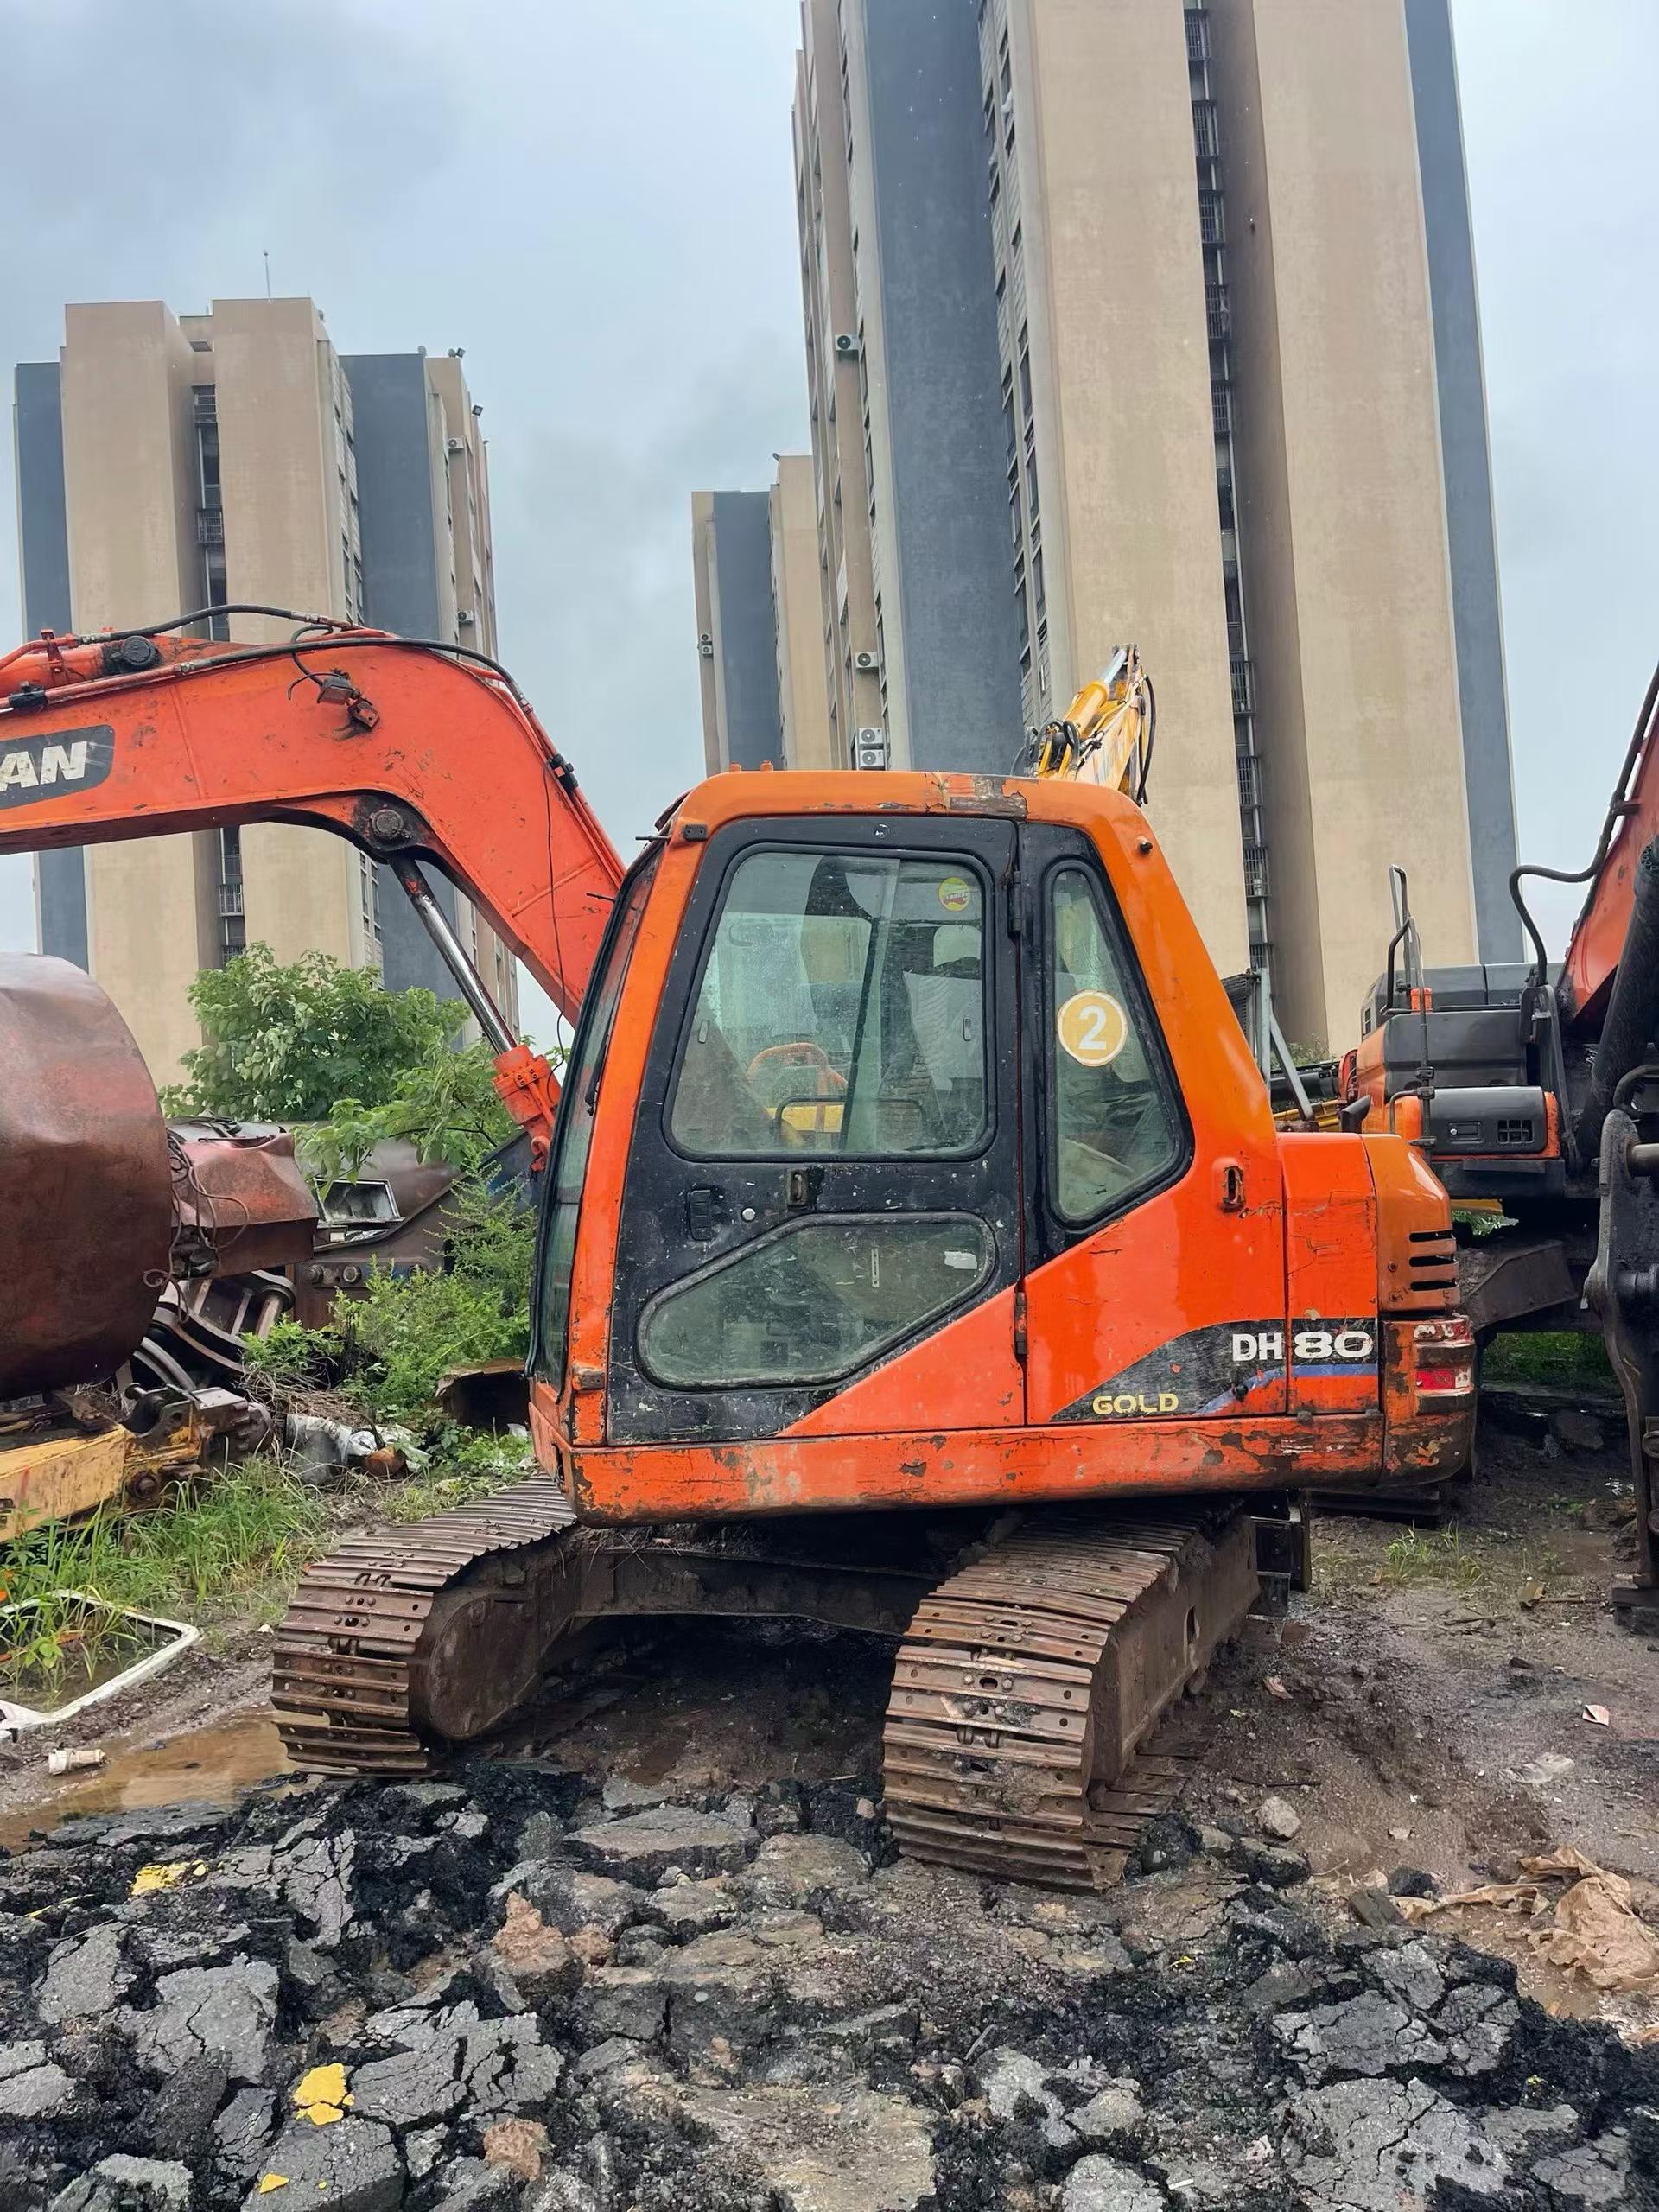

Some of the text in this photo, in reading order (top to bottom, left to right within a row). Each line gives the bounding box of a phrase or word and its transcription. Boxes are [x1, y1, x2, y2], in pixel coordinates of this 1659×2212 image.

[0, 741, 87, 792] AN
[1078, 1005, 1107, 1050] 2
[1092, 1393, 1179, 1415] GOLD
